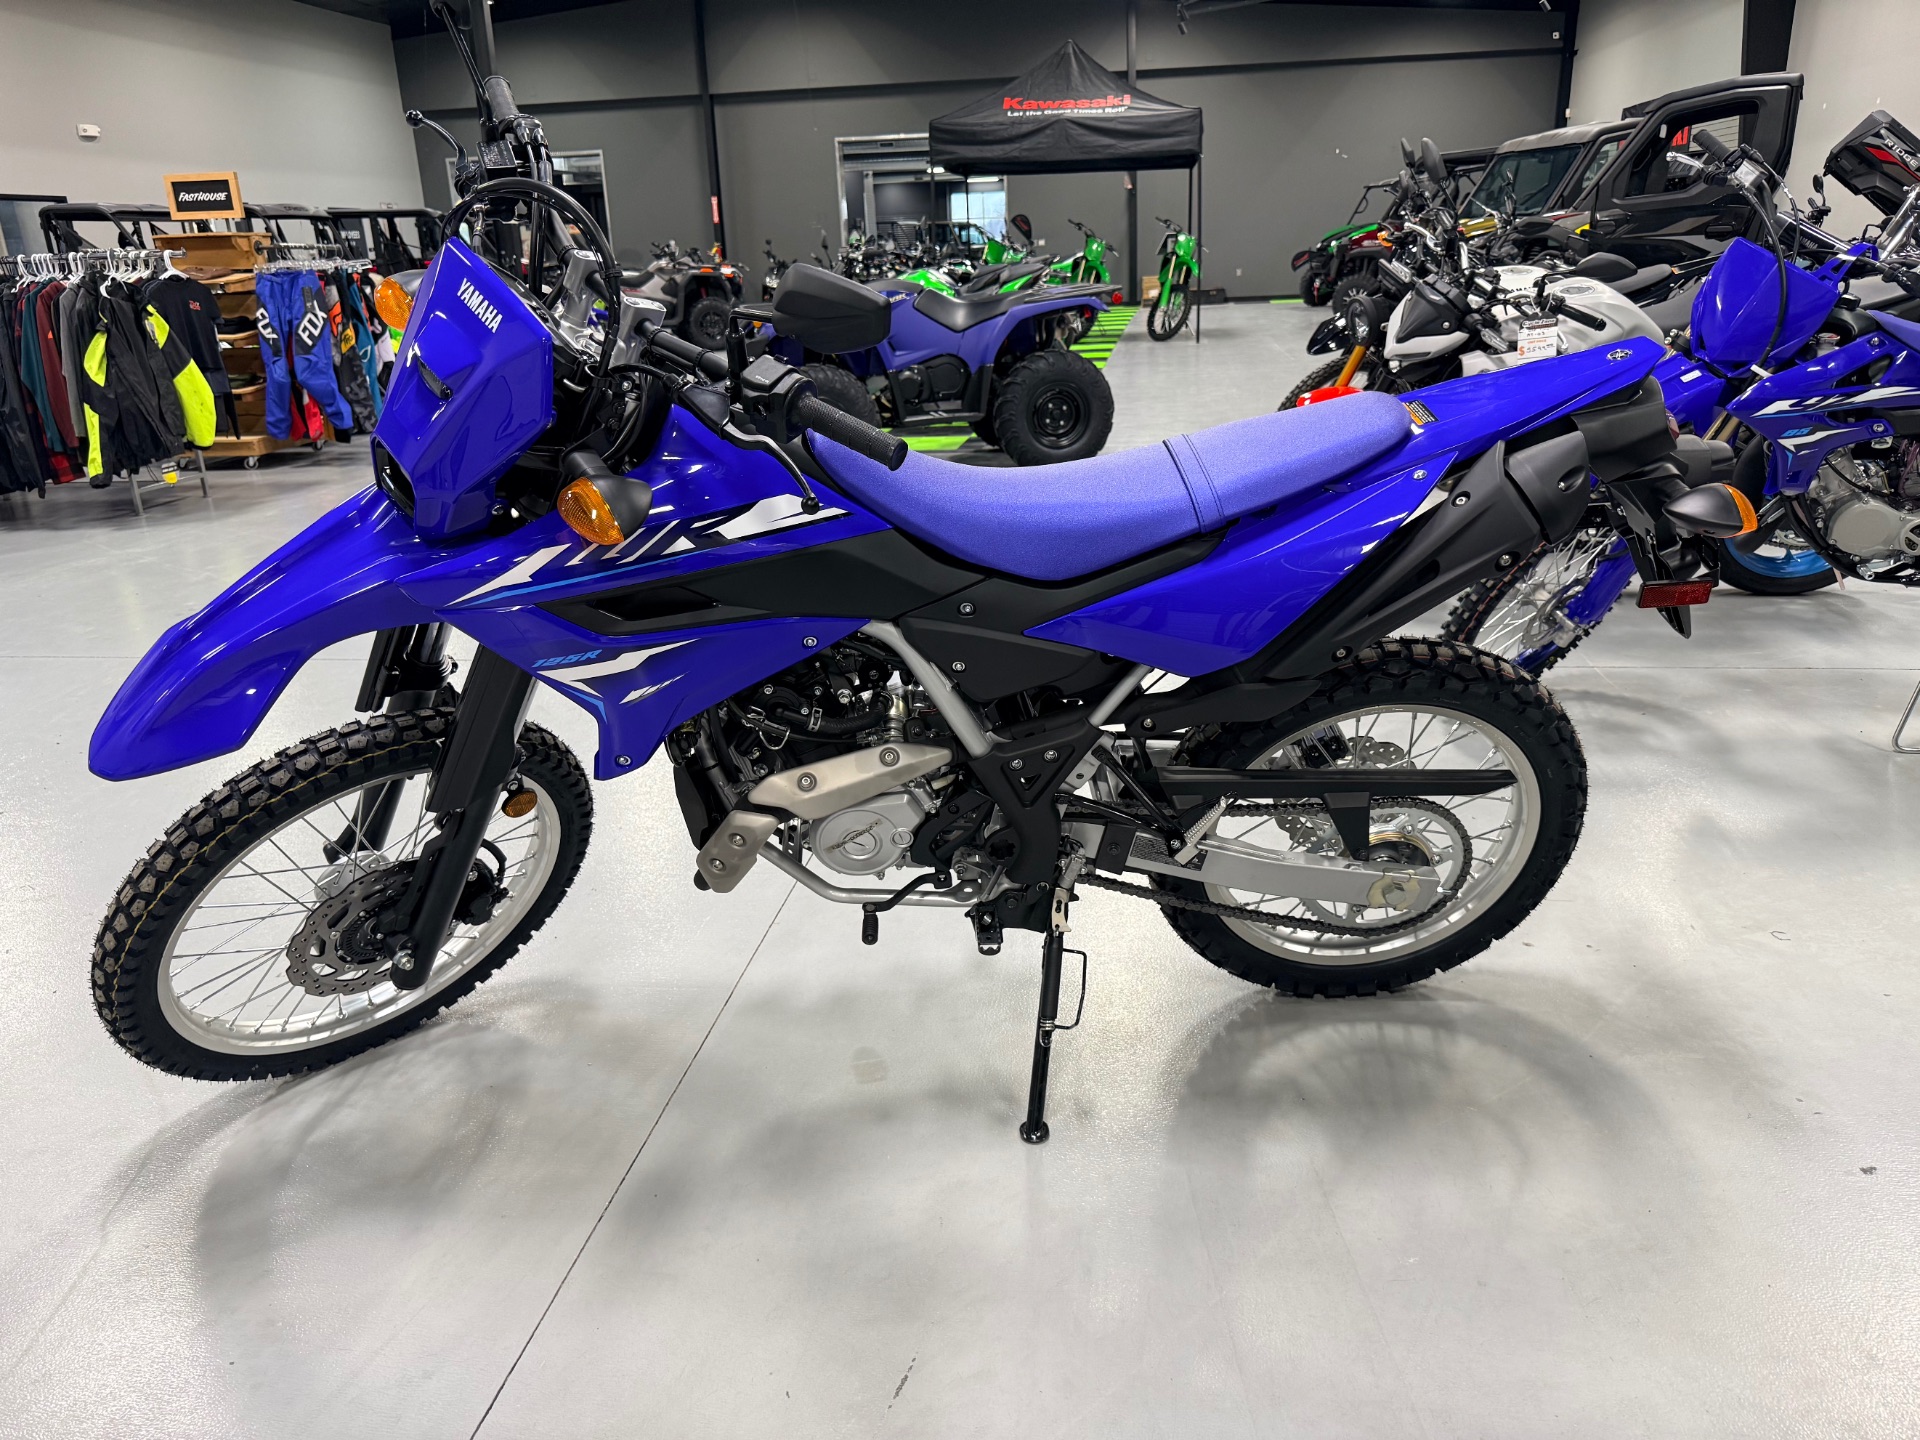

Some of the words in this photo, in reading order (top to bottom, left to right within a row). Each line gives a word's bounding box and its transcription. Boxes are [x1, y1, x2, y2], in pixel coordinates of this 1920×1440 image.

[1003, 95, 1131, 109] Kawasaki
[1007, 109, 1024, 117] Let
[1884, 138, 1919, 168] RIDGE
[457, 277, 503, 334] YAMAHA
[298, 300, 328, 347] FOX
[1780, 426, 1814, 438] 85
[531, 649, 603, 668] 125R
